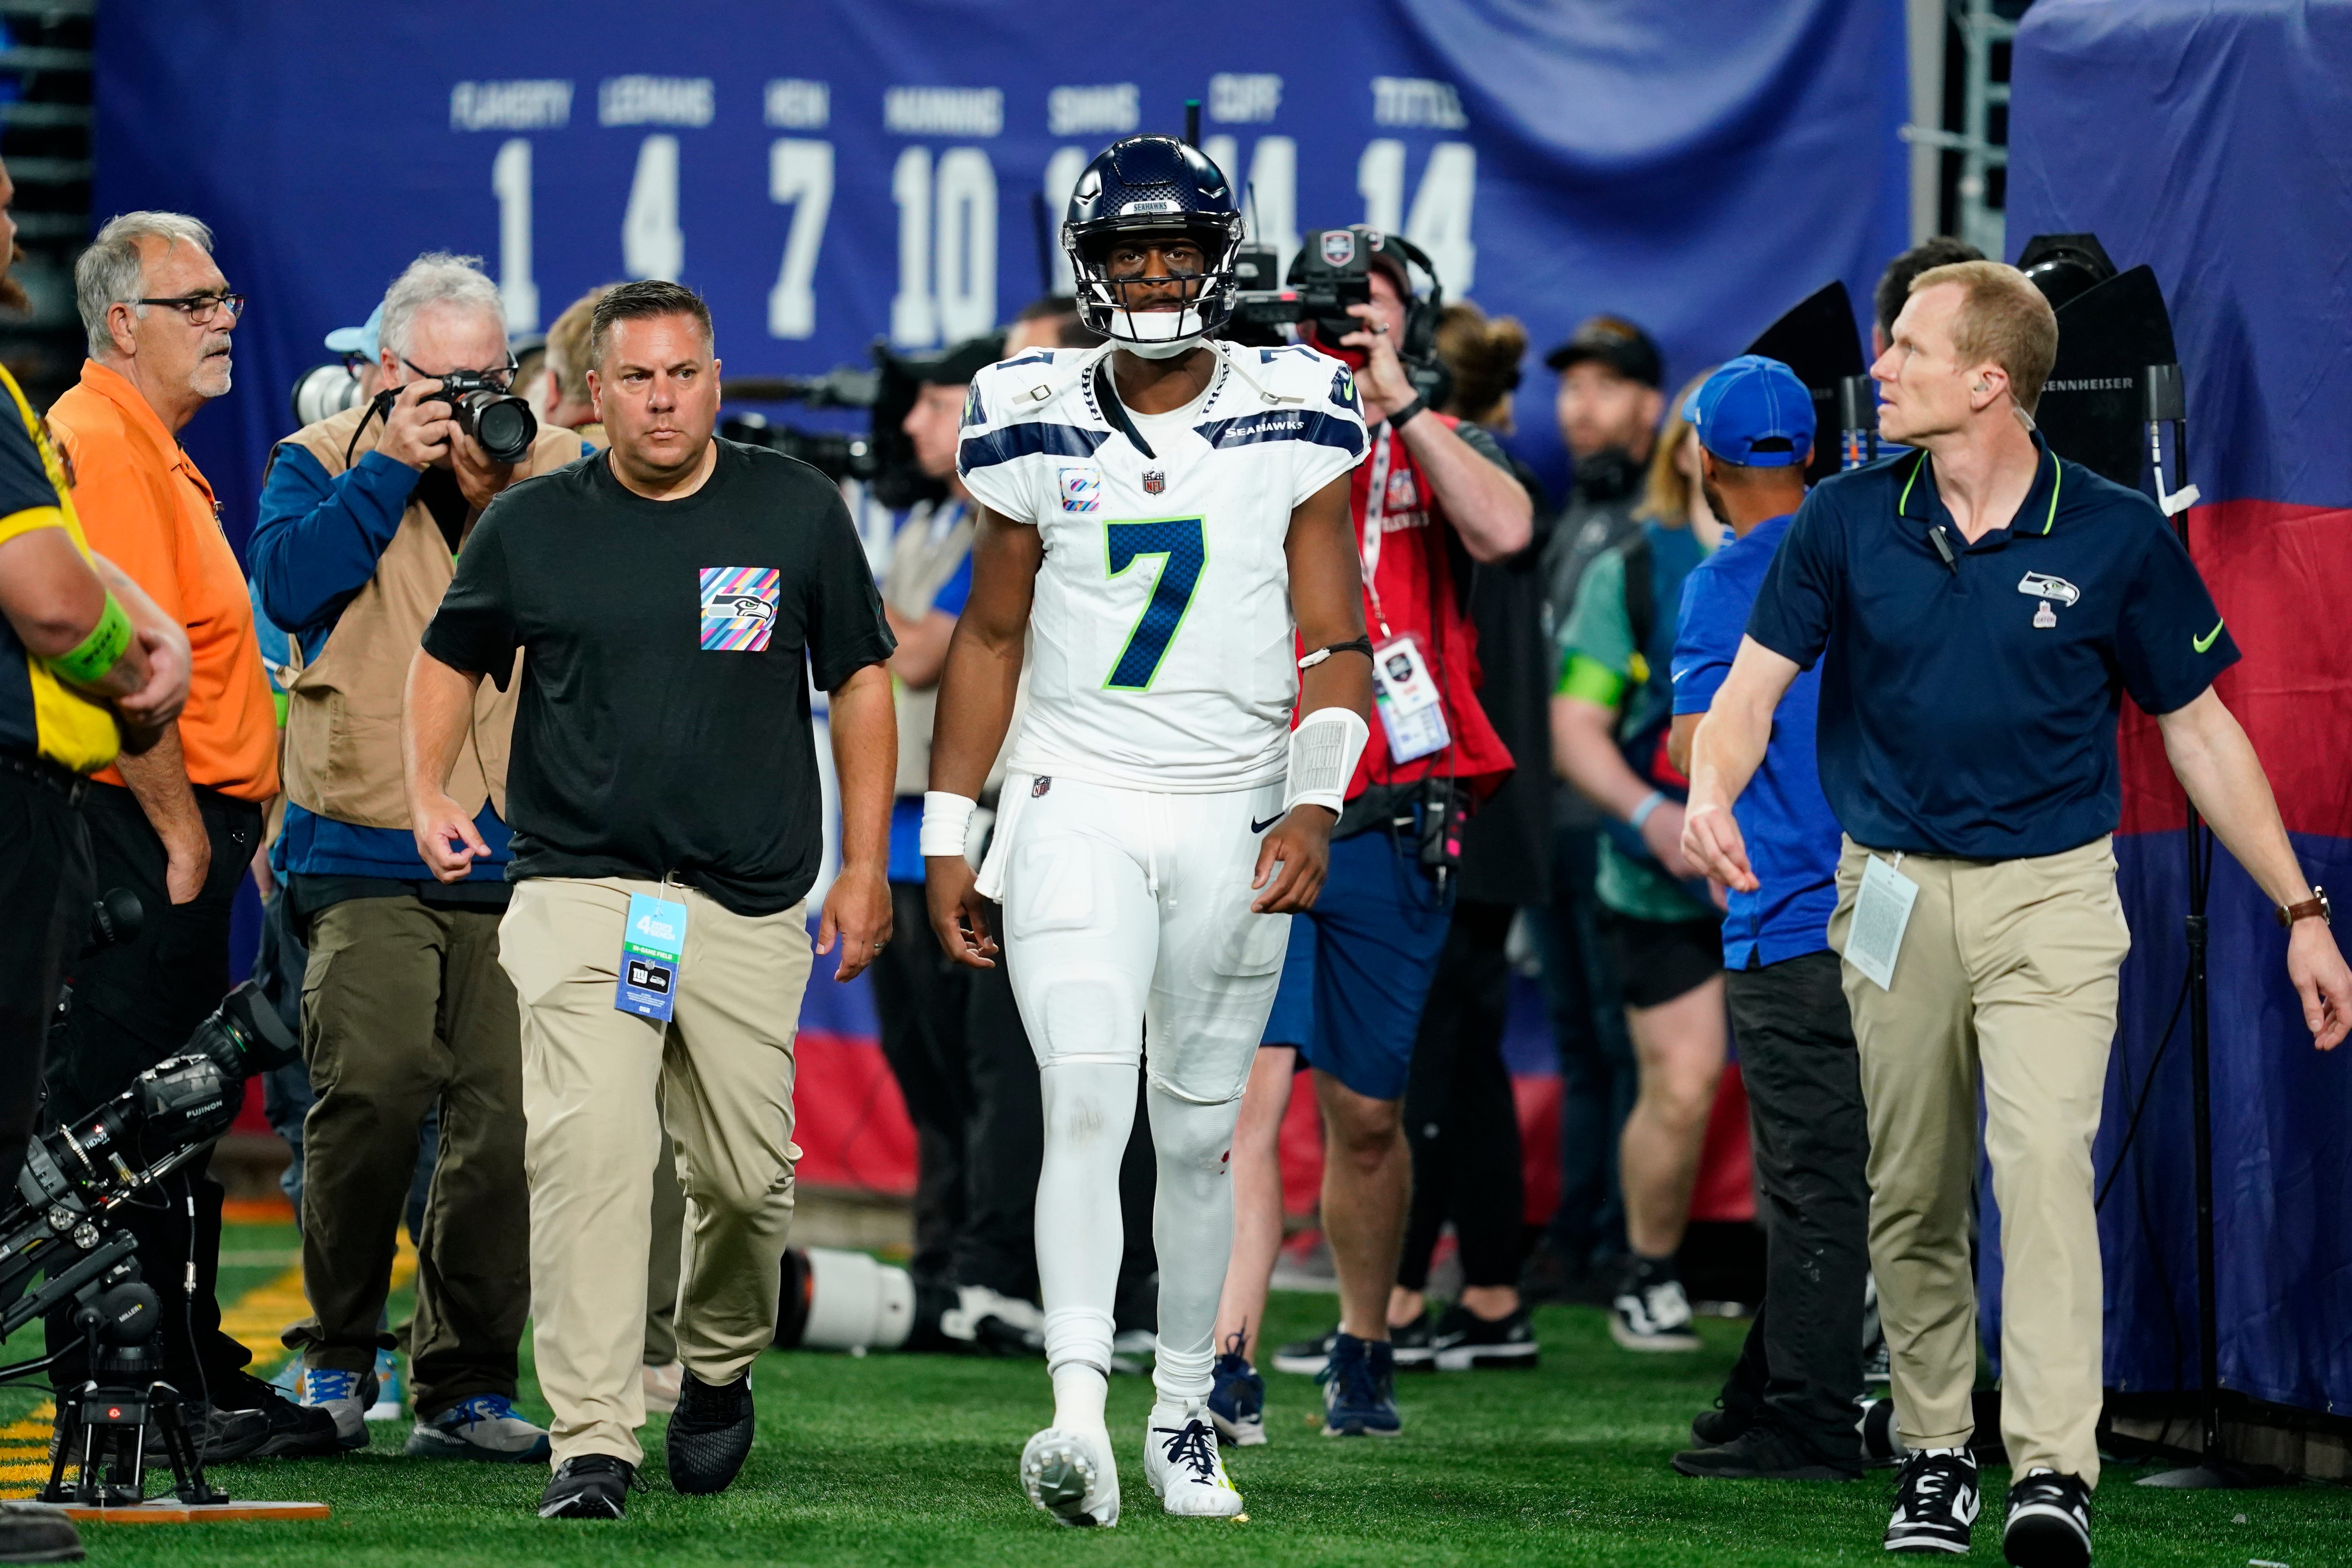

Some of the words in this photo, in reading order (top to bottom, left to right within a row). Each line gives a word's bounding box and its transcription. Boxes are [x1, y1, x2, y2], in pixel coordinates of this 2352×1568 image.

[621, 133, 686, 282] 4
[1134, 202, 1167, 212] SEAHAWKS
[492, 137, 540, 331] 1
[767, 137, 835, 341] 7
[890, 145, 999, 349] 10
[1225, 421, 1304, 438] SEAHAWKS
[1146, 481, 1163, 492] NFL
[1102, 514, 1209, 692] 7
[637, 915, 651, 934] 4
[656, 951, 673, 960] FIELD
[186, 1100, 223, 1119] FUJINON
